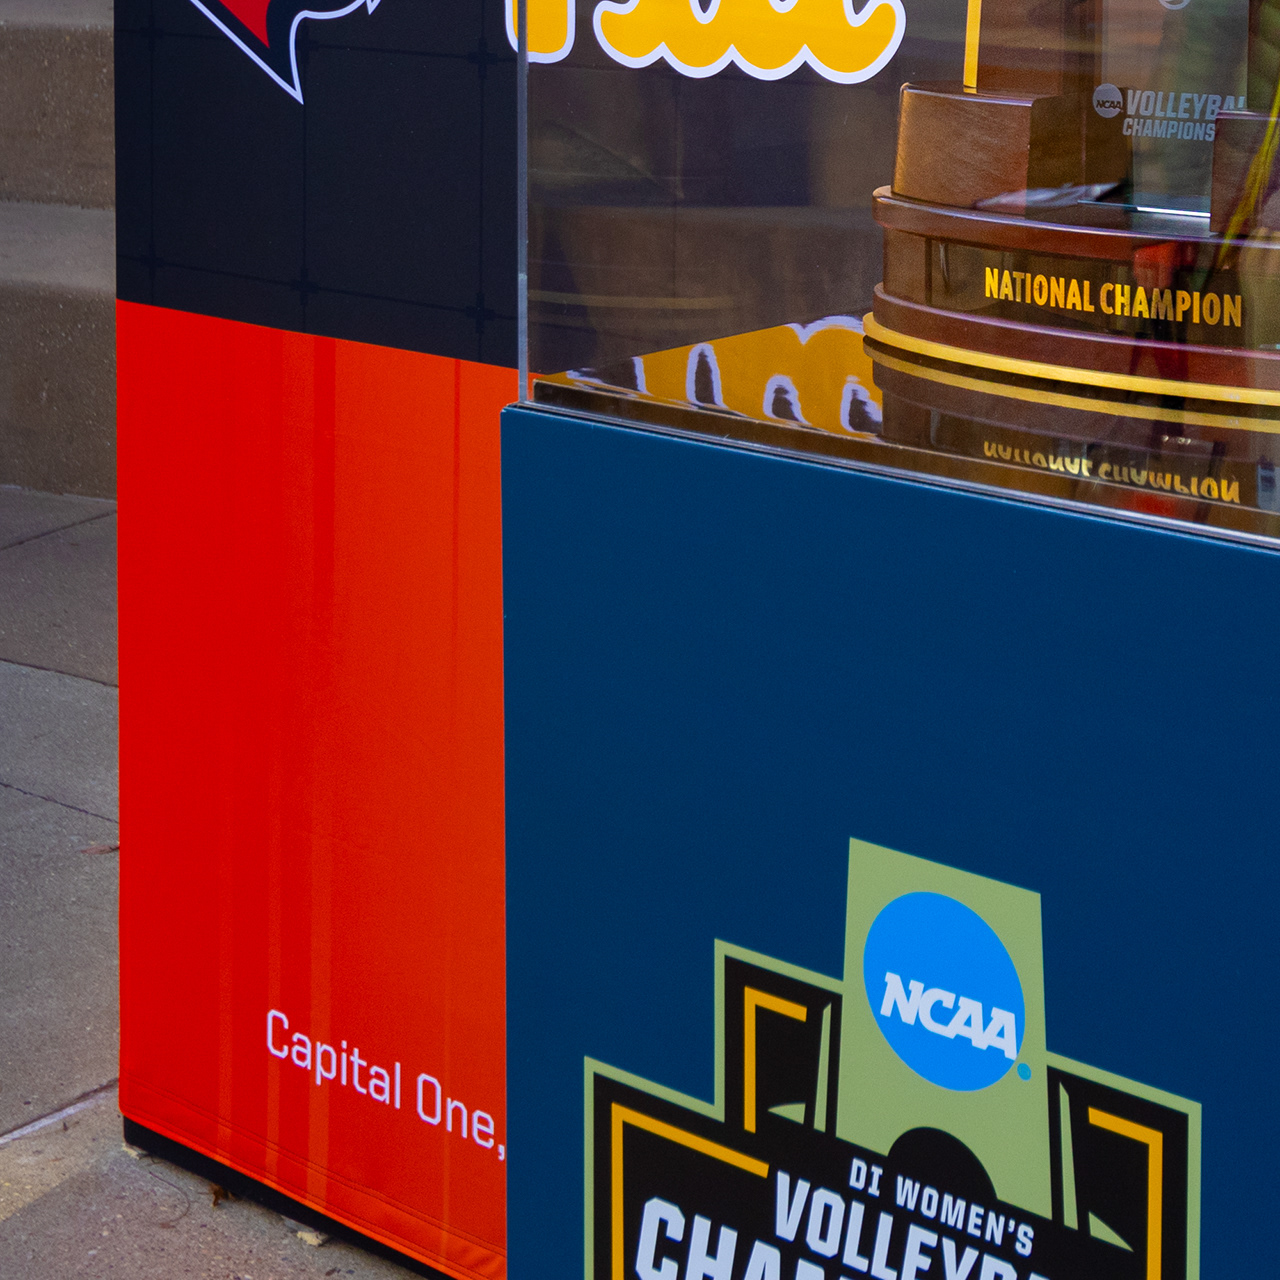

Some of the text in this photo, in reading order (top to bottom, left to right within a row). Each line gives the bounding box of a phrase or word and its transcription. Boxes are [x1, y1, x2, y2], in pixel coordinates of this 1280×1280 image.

[1095, 99, 1124, 111] NCAA
[985, 267, 1241, 327] NATIONAL CHAMPION
[880, 971, 1018, 1061] NCAA
[267, 1009, 505, 1161] Capital One,
[849, 1157, 1034, 1257] DI WOMEN'S
